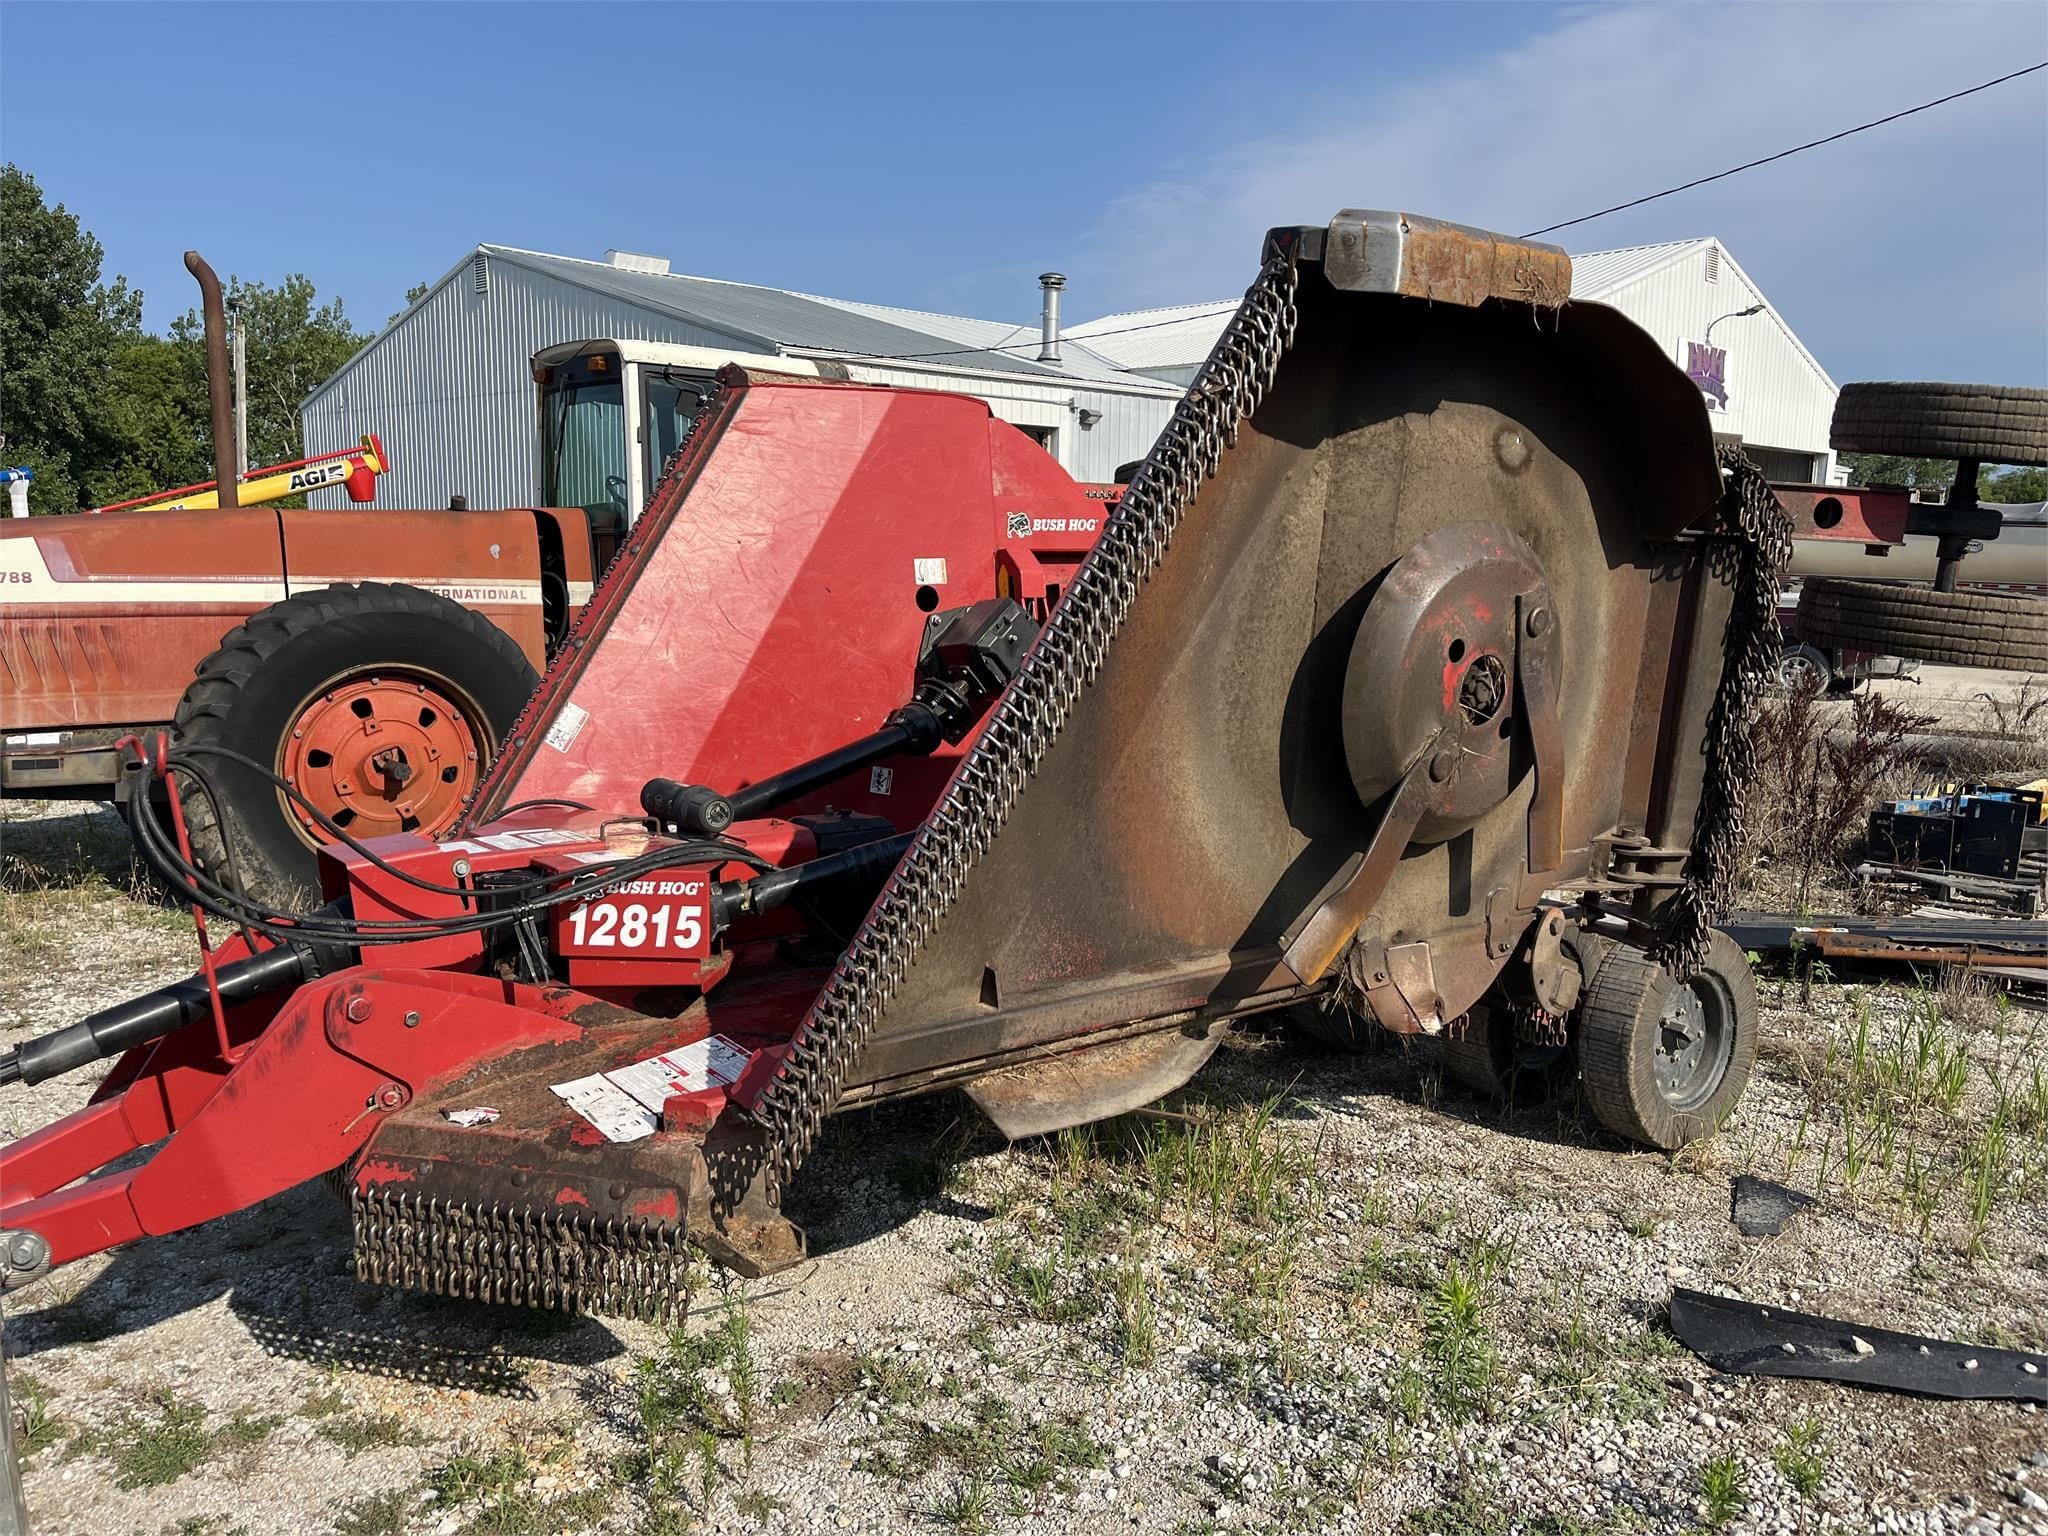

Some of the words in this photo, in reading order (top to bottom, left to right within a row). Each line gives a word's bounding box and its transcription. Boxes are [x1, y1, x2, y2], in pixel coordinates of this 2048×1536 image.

[290, 468, 327, 490] AGI
[1032, 518, 1067, 532] BUSH
[1067, 518, 1096, 532] HOG
[0, 571, 33, 584] 788
[431, 588, 528, 600] ERNATIONAL
[606, 880, 656, 895] BUSH
[657, 881, 699, 896] HOG
[569, 902, 702, 949] 12815
